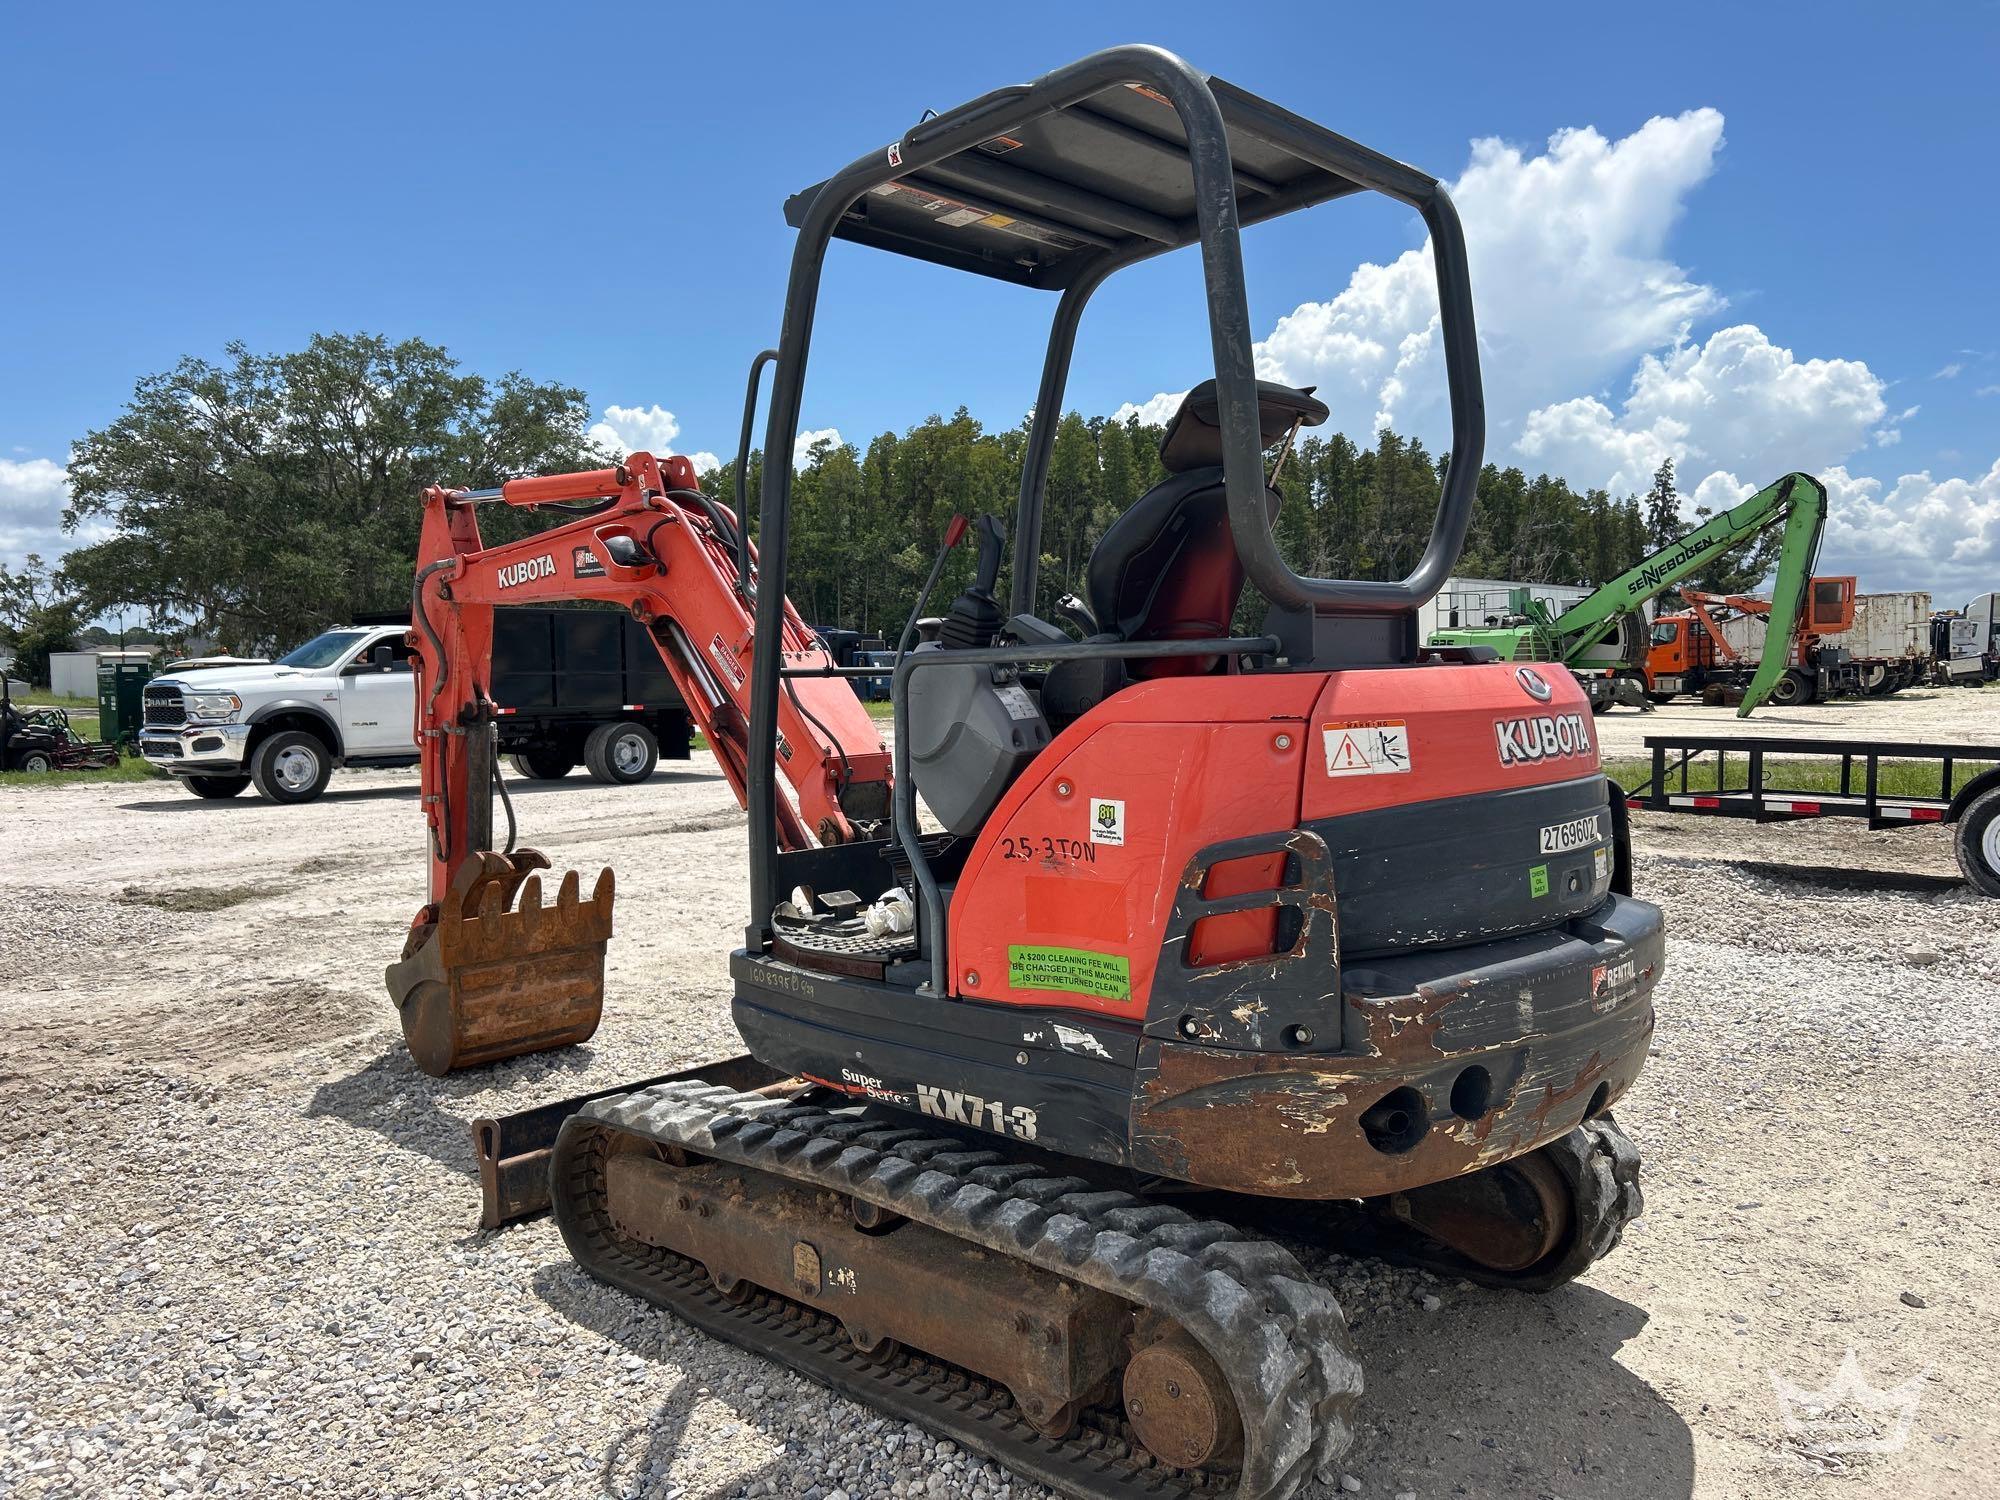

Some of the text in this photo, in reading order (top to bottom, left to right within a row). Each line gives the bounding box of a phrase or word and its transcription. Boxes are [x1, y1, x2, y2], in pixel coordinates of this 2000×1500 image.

[497, 554, 557, 589] KUBOTA
[1627, 534, 1714, 595] SENNEBOGEN
[720, 645, 738, 673] DANGER
[1346, 721, 1388, 729] WARNING
[1495, 713, 1591, 764] KUBOTA
[1098, 804, 1115, 820] 811
[1543, 817, 1595, 851] 2769602
[1012, 963, 1127, 984] BE CHARGED IF THIS MACHINE
[1027, 953, 1046, 961] $200
[1048, 954, 1087, 966] CLEANING
[1088, 958, 1101, 968] FEE
[1102, 960, 1120, 972] WILL
[1023, 974, 1119, 993] IS NOT RETURNED CLEAN
[841, 1068, 882, 1088] Super
[916, 1083, 1037, 1141] KX71-3
